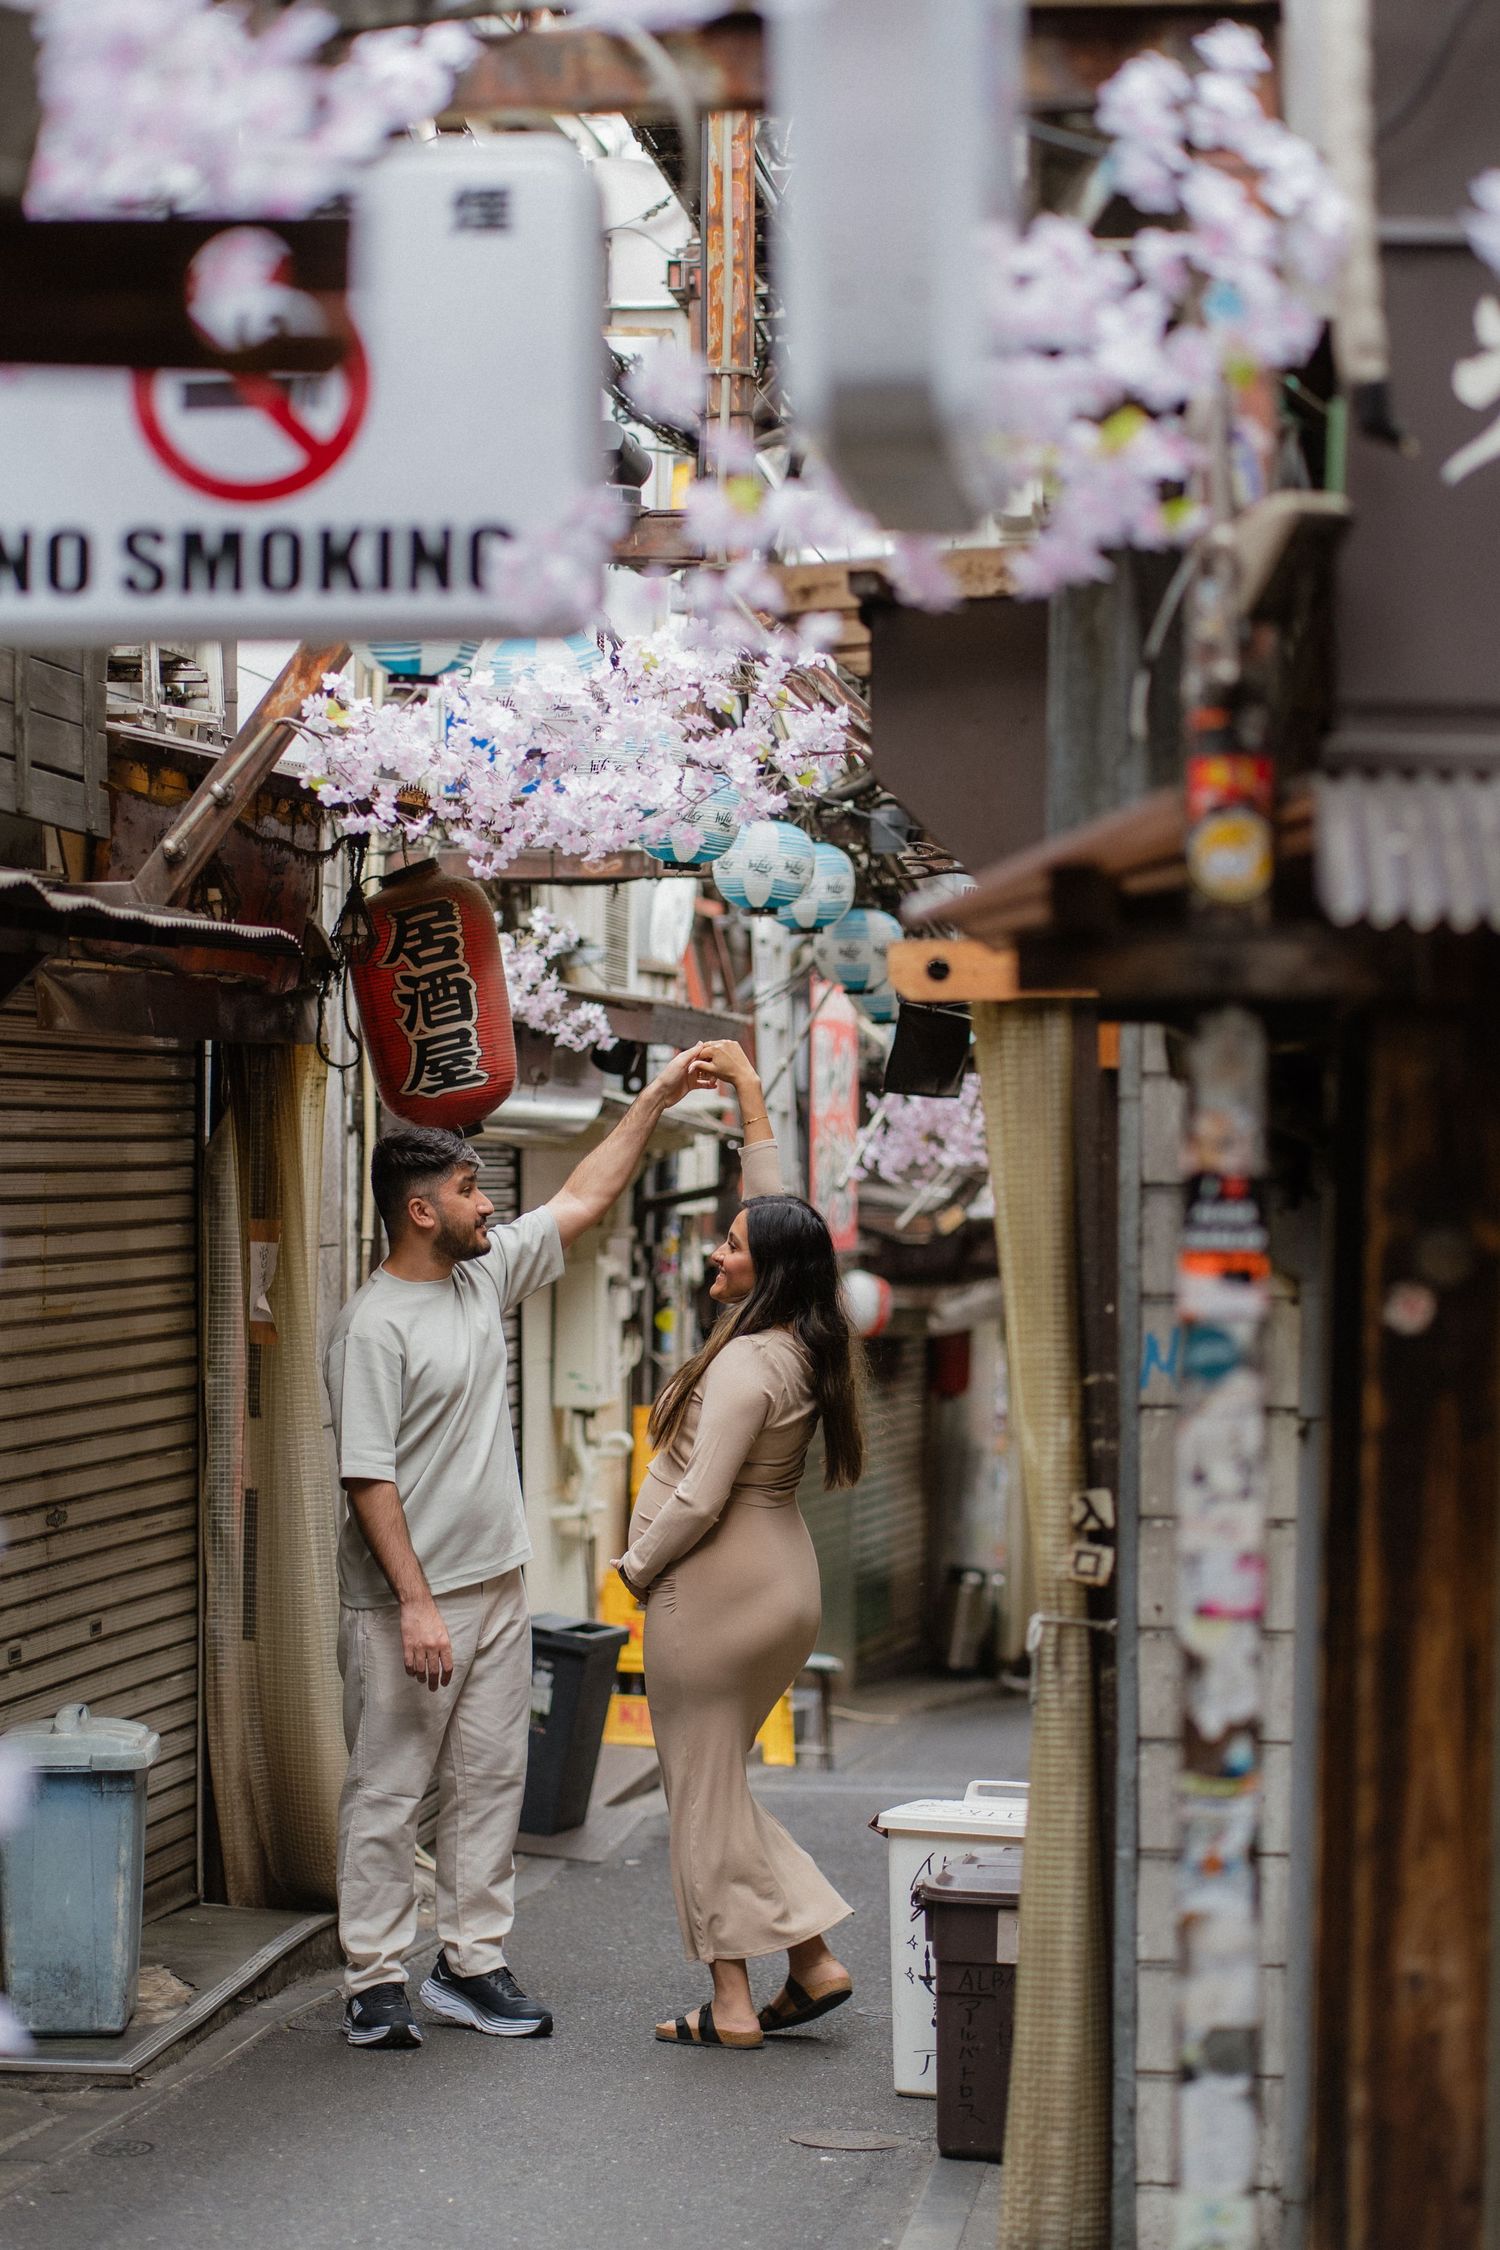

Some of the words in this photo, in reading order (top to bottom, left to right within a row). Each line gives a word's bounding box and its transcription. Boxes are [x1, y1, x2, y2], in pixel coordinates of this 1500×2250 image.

[0, 528, 90, 595] NO
[377, 897, 489, 1098] 居酒屋
[957, 1999, 985, 2124] アルバトロス
